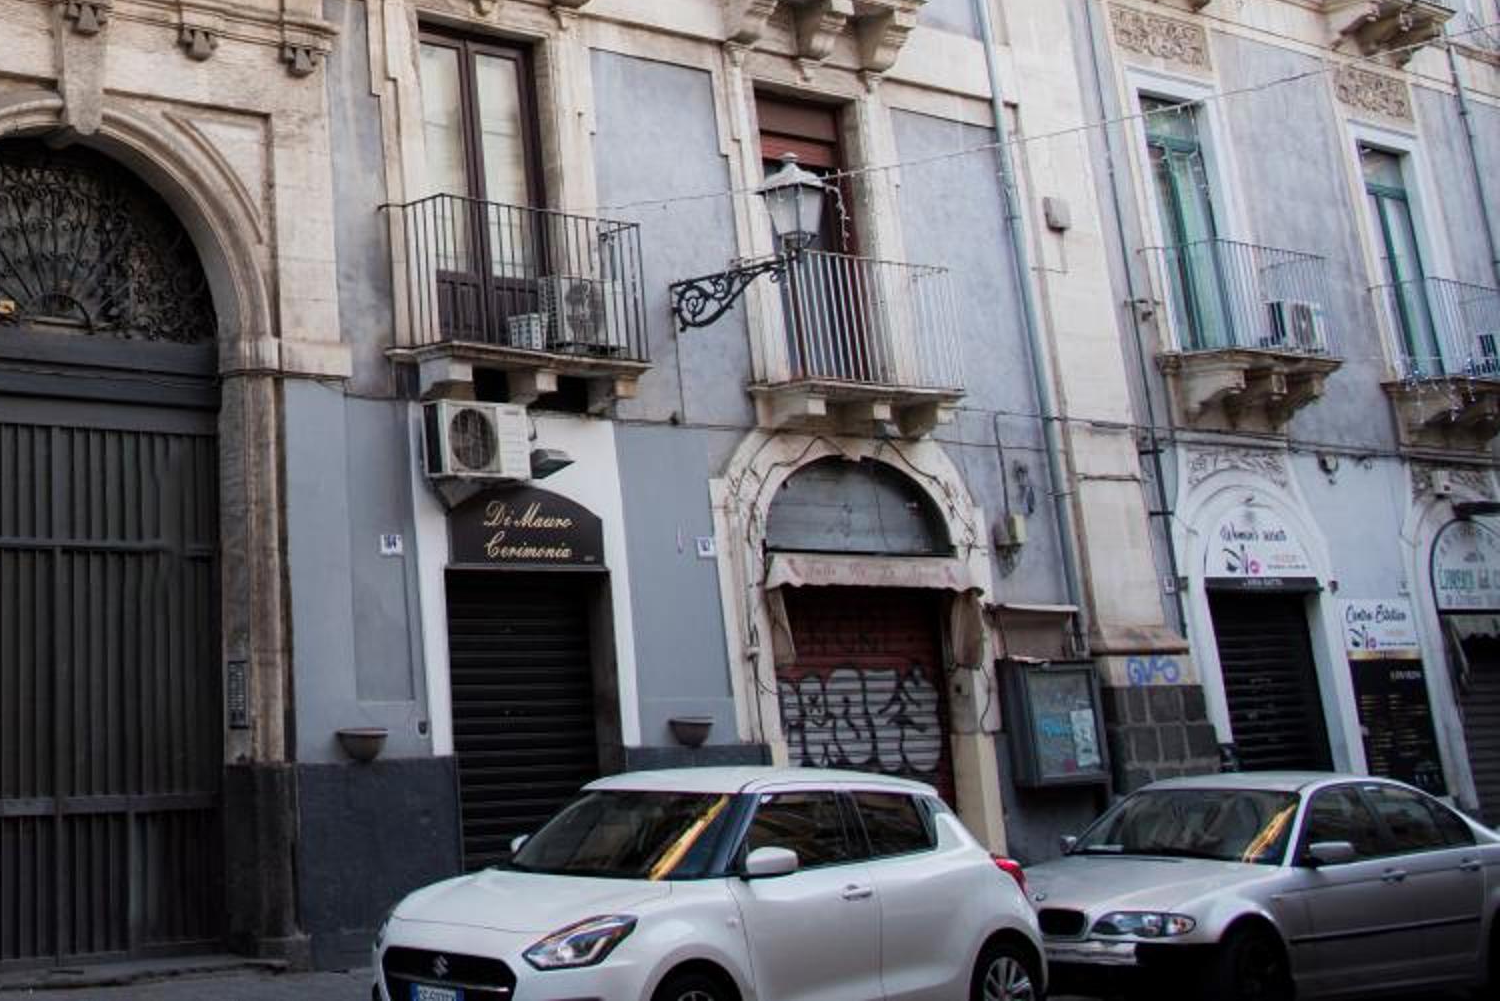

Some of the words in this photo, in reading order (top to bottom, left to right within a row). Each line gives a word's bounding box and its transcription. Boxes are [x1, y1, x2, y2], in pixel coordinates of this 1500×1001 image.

[484, 500, 514, 527] Di
[514, 502, 572, 528] Mauro
[484, 530, 573, 558] Cerimonia
